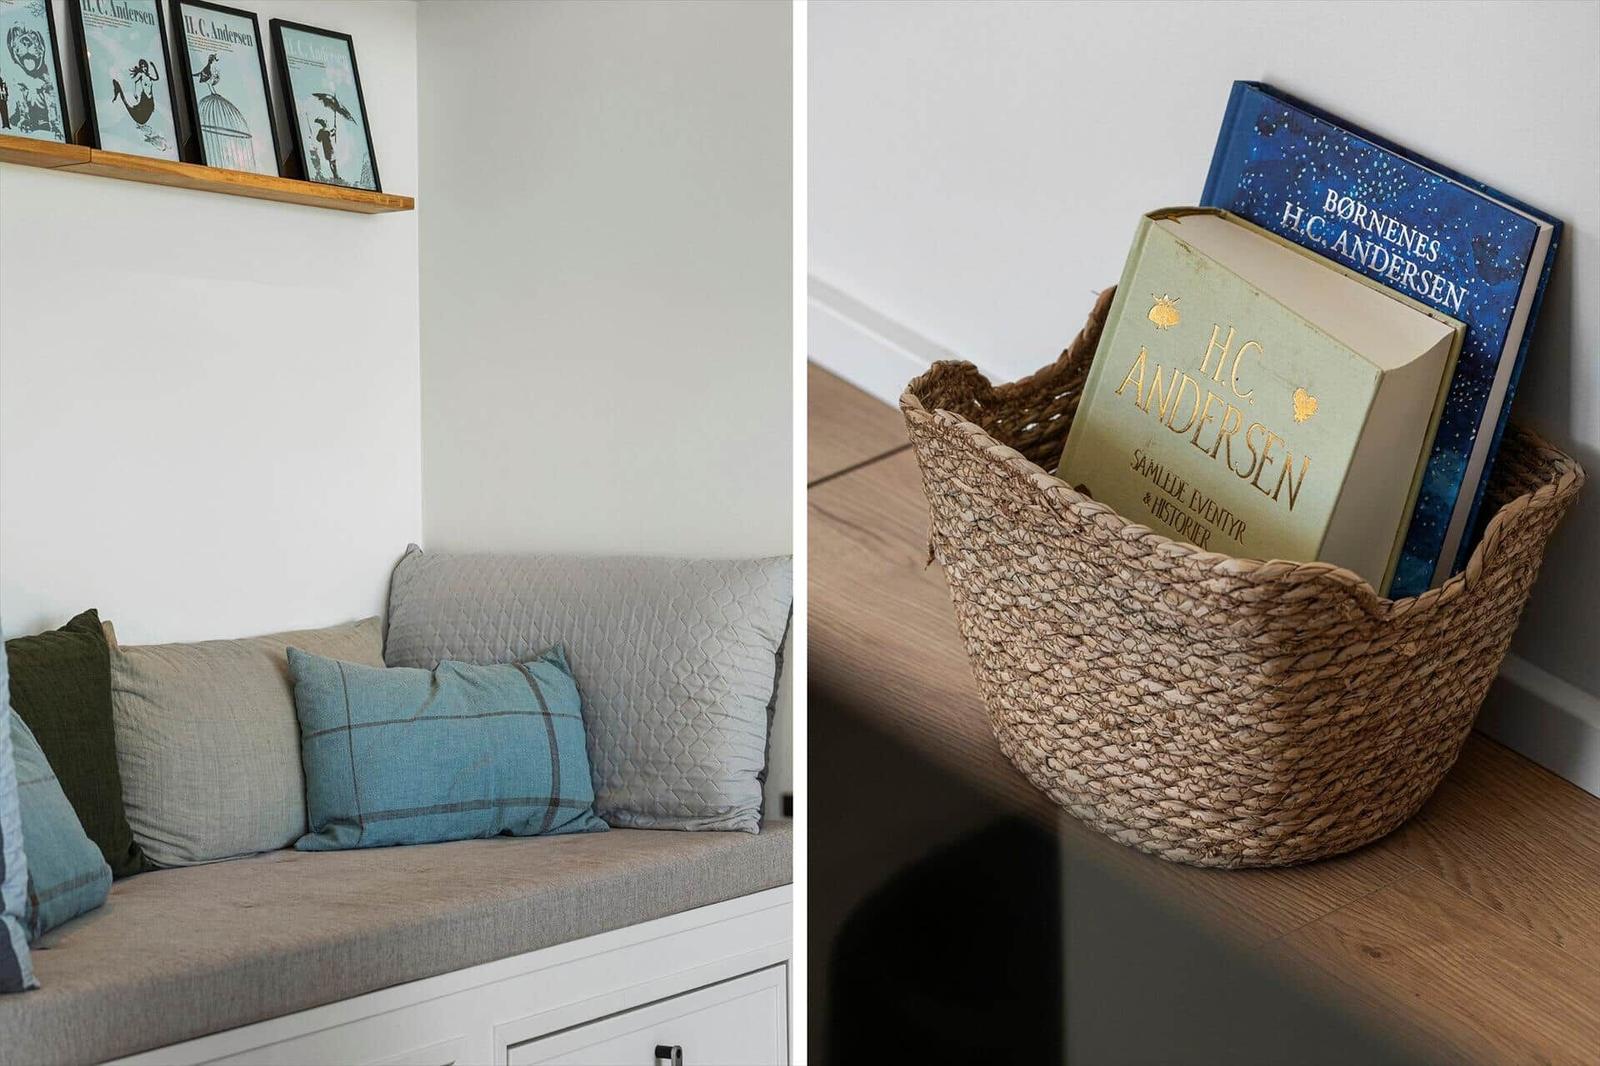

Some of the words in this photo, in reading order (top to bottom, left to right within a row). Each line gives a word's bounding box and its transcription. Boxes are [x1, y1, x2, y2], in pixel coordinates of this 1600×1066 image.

[110, 0, 155, 26] Andersen
[184, 15, 197, 35] H.
[198, 18, 210, 37] C.
[211, 21, 254, 47] Andersen
[1322, 188, 1441, 263] BØRNENES
[1331, 230, 1467, 312] ANDERSEN
[1198, 323, 1265, 405] H.C.
[1115, 345, 1312, 511] ANDERSEN
[1130, 448, 1189, 503] SAMLEDE
[1191, 488, 1248, 545] EVENTYR
[1143, 491, 1151, 506] &
[1151, 498, 1211, 551] HISTORIER
